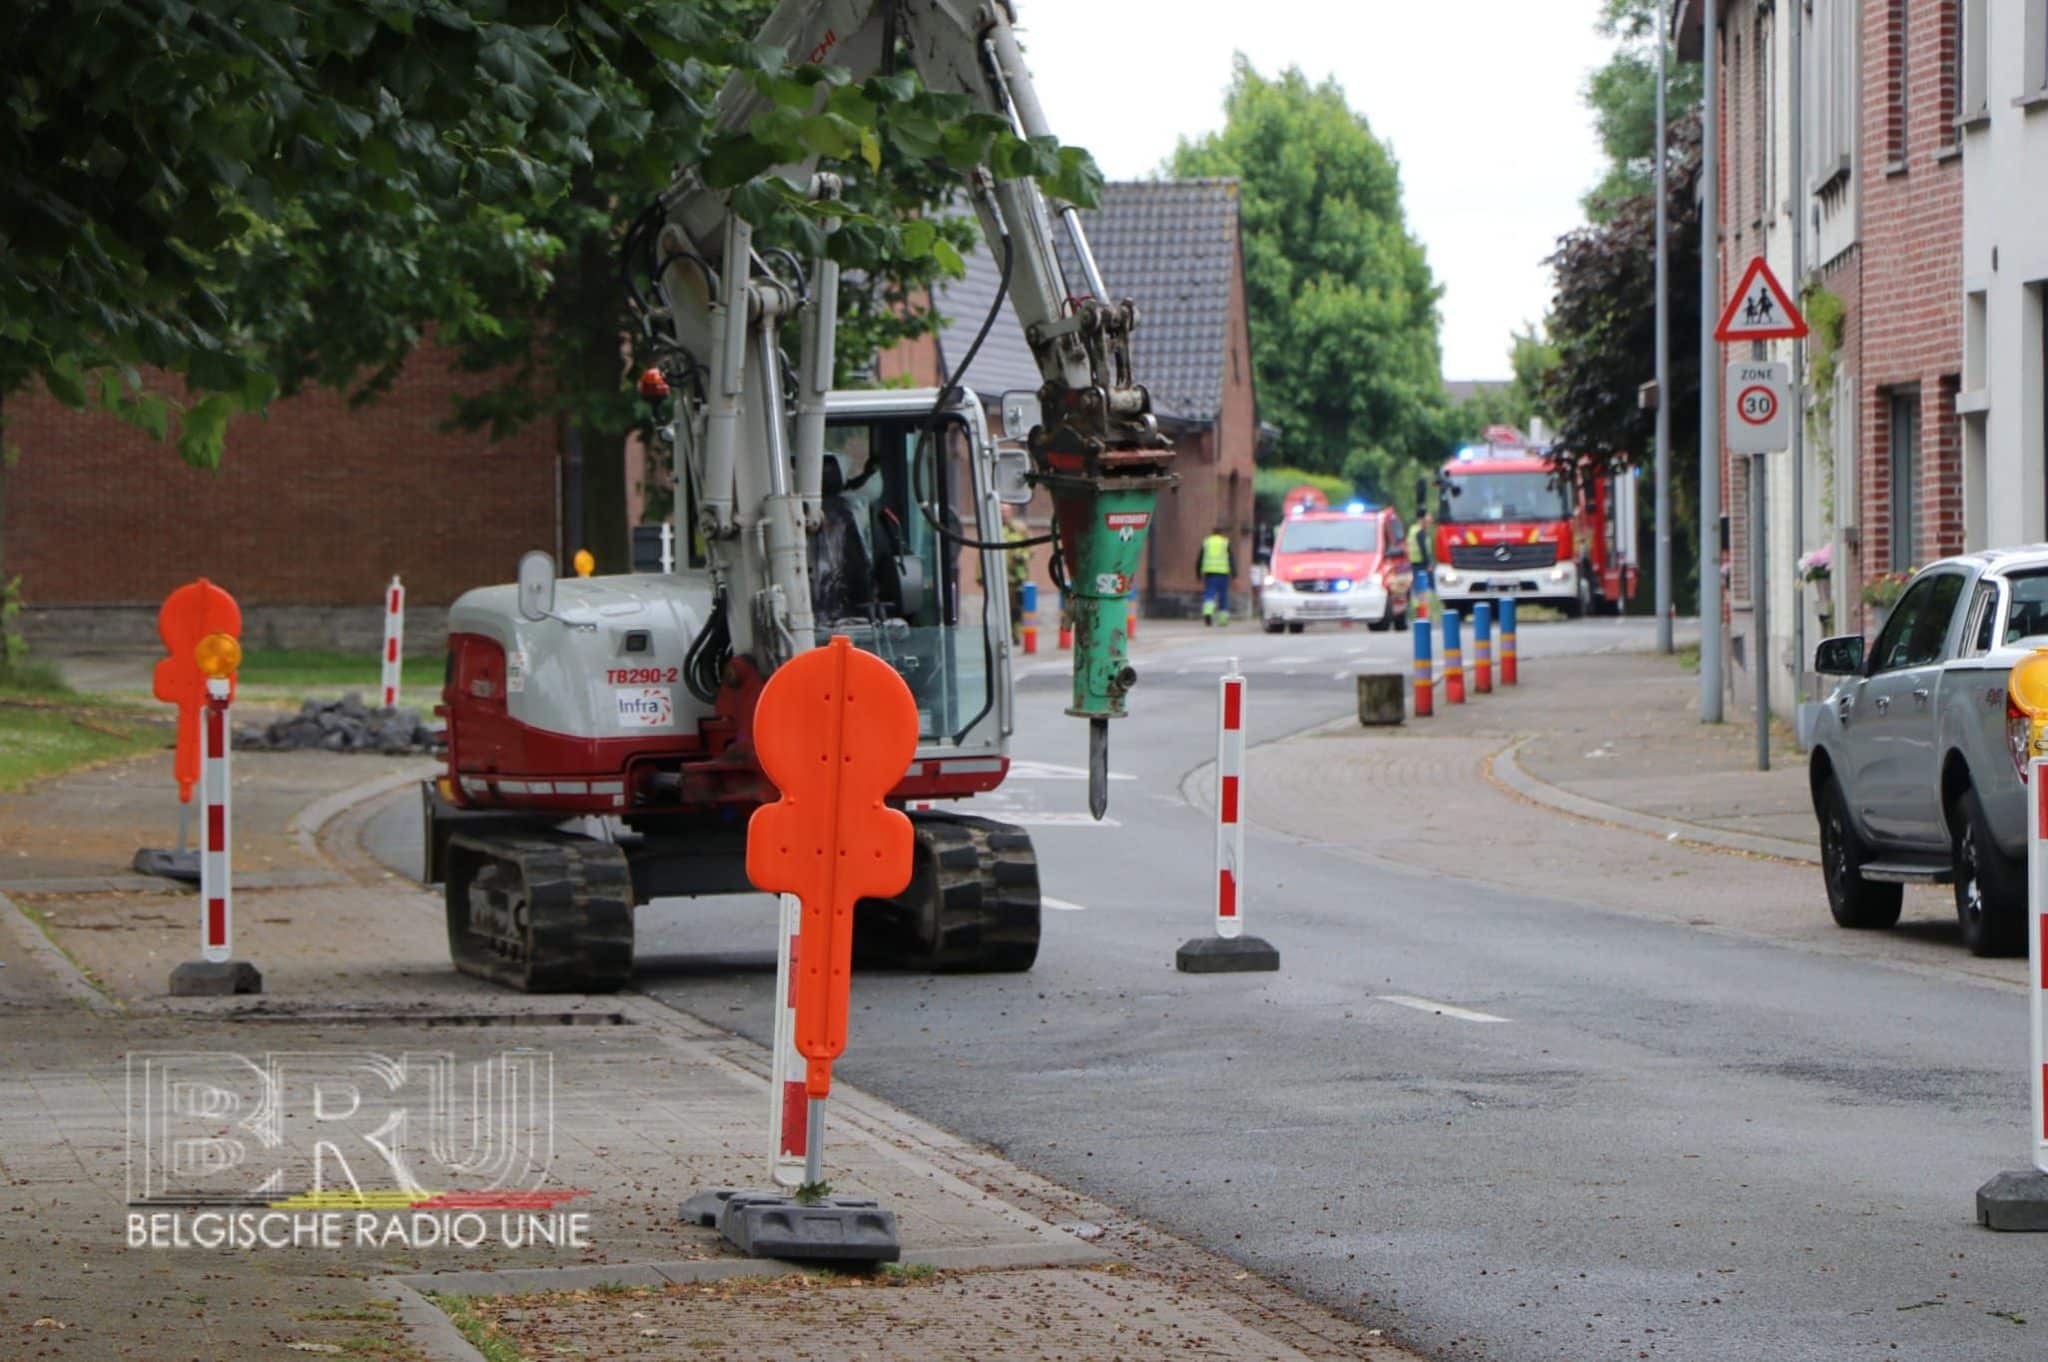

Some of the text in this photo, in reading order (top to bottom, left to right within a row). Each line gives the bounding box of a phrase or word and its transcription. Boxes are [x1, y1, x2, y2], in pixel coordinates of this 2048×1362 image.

[1741, 368, 1773, 381] ZONE
[1745, 397, 1770, 414] 30
[607, 667, 679, 685] TB290-2
[619, 699, 659, 713] Infra
